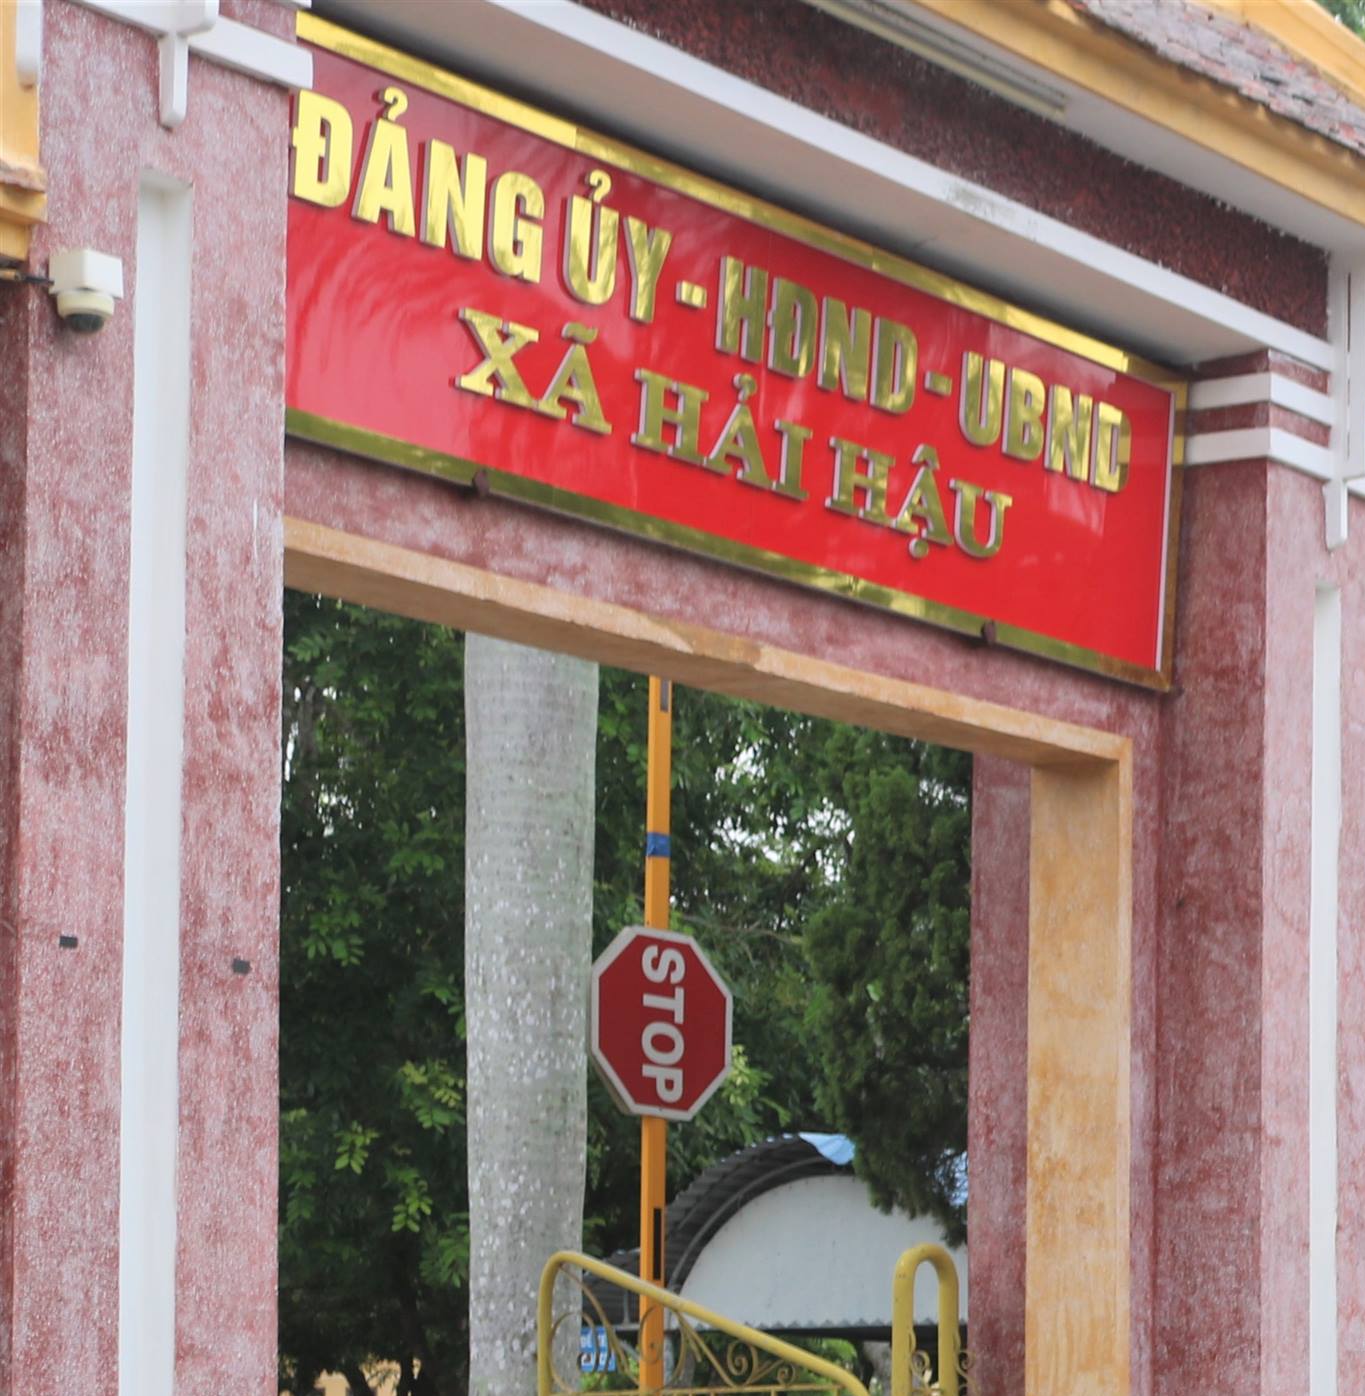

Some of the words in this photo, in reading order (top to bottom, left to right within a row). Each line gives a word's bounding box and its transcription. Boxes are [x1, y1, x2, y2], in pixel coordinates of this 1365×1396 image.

[290, 86, 543, 284] ĐẢNG
[454, 307, 611, 434] XÃ
[631, 369, 813, 501] HẢI
[824, 437, 1013, 558] HẬU
[642, 946, 684, 1103] STOP
